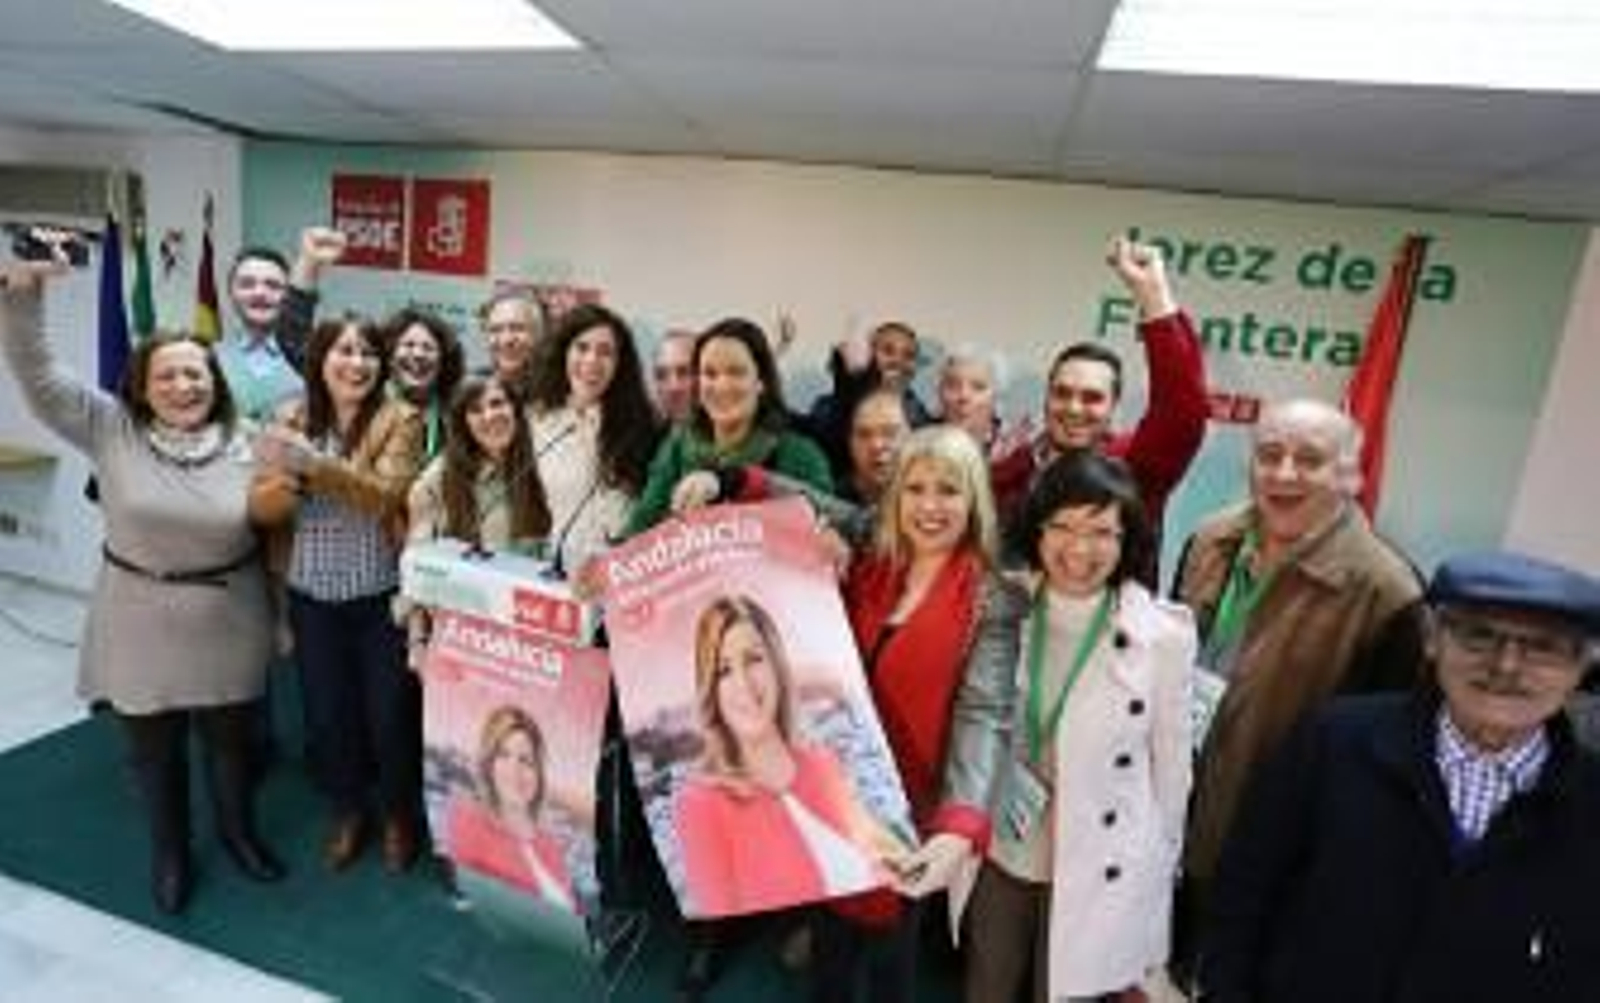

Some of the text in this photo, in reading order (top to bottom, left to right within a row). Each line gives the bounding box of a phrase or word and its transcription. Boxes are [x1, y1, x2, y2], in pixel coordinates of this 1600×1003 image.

[1127, 226, 1275, 285] rez
[1297, 243, 1376, 294] de
[1096, 297, 1361, 367] Fntera
